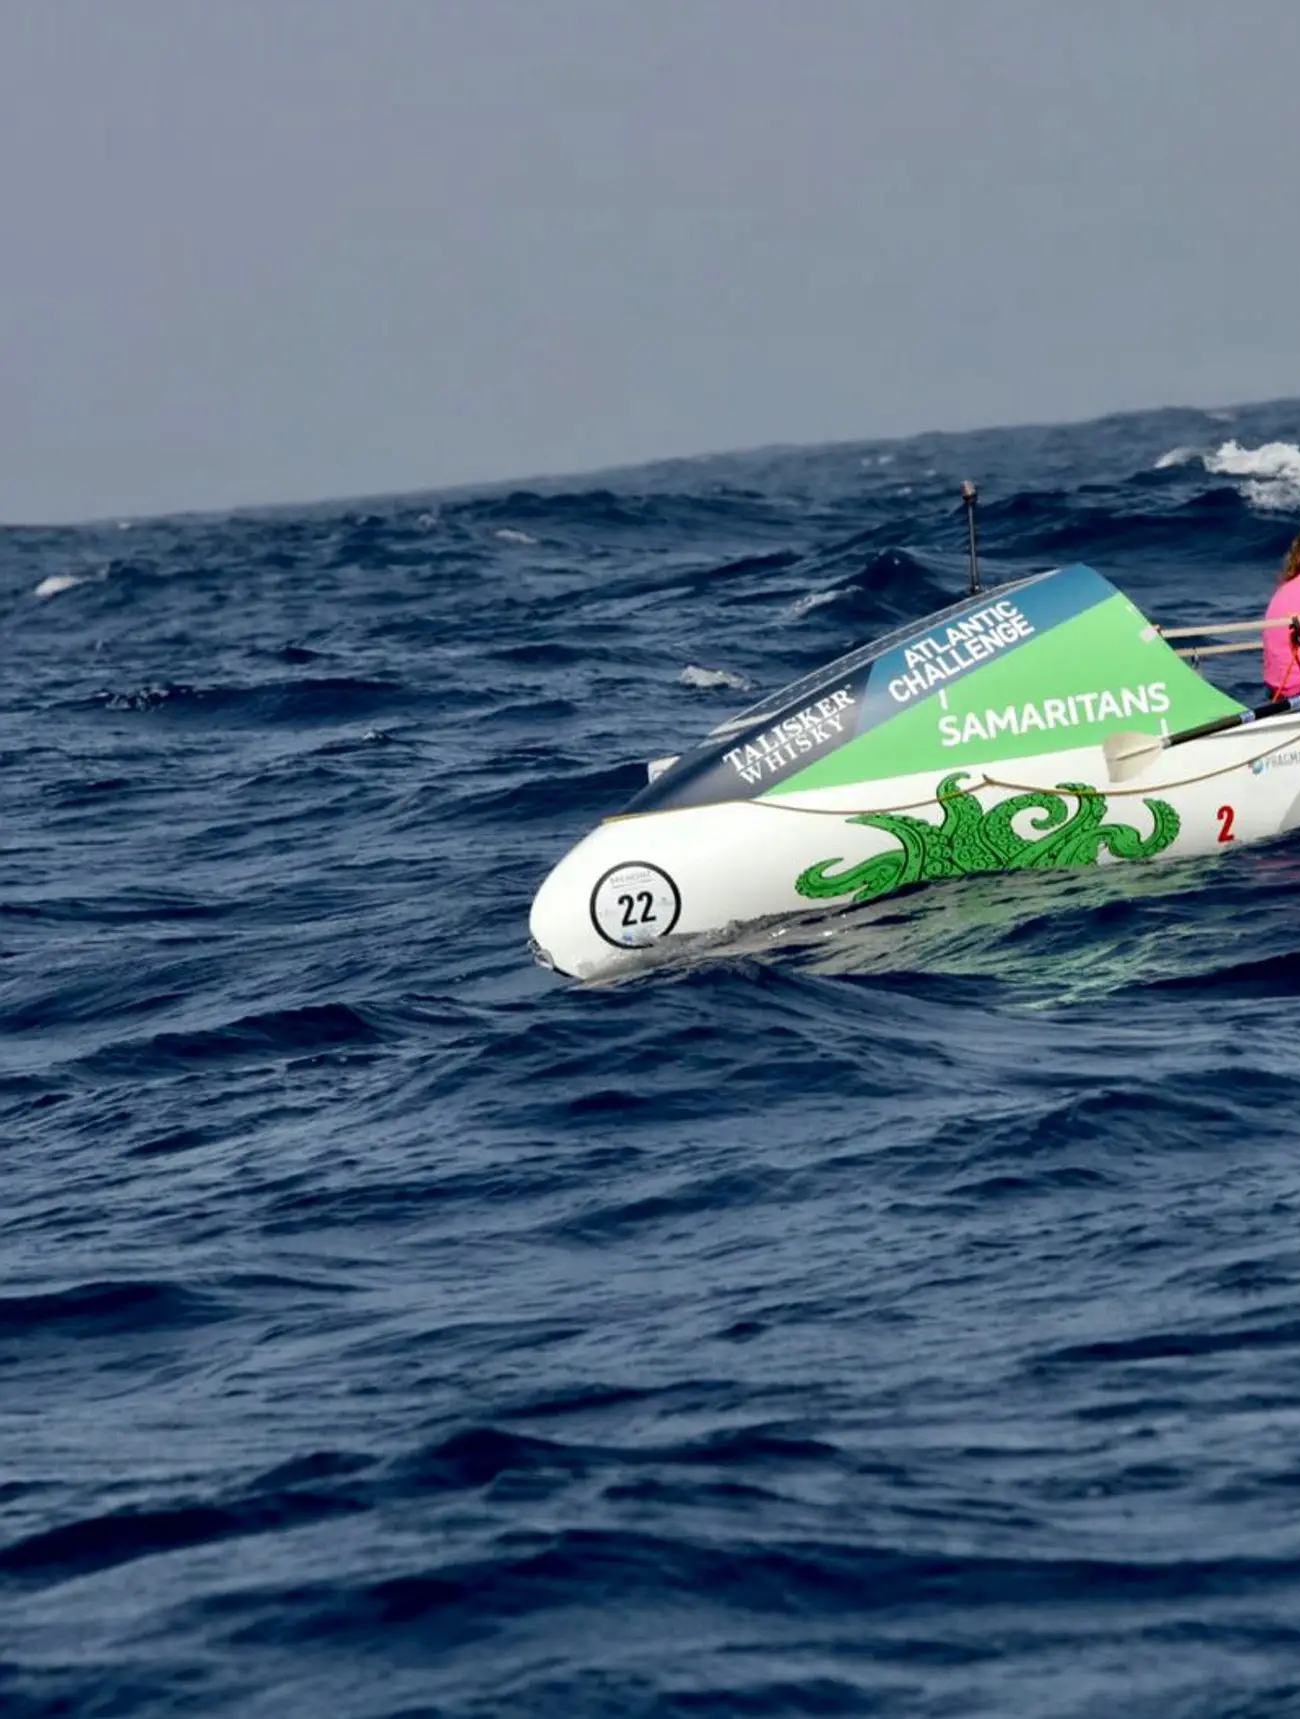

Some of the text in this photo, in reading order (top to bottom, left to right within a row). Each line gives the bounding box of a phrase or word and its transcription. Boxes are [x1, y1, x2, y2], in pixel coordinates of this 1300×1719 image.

[888, 614, 1035, 703] CHALLENGE
[903, 601, 1019, 670] ATLANTIC
[722, 687, 855, 772] TALISKER
[938, 682, 1171, 747] SAMARITANS
[739, 714, 846, 785] WHISKY
[1217, 805, 1235, 844] 2
[618, 891, 657, 928] 22
